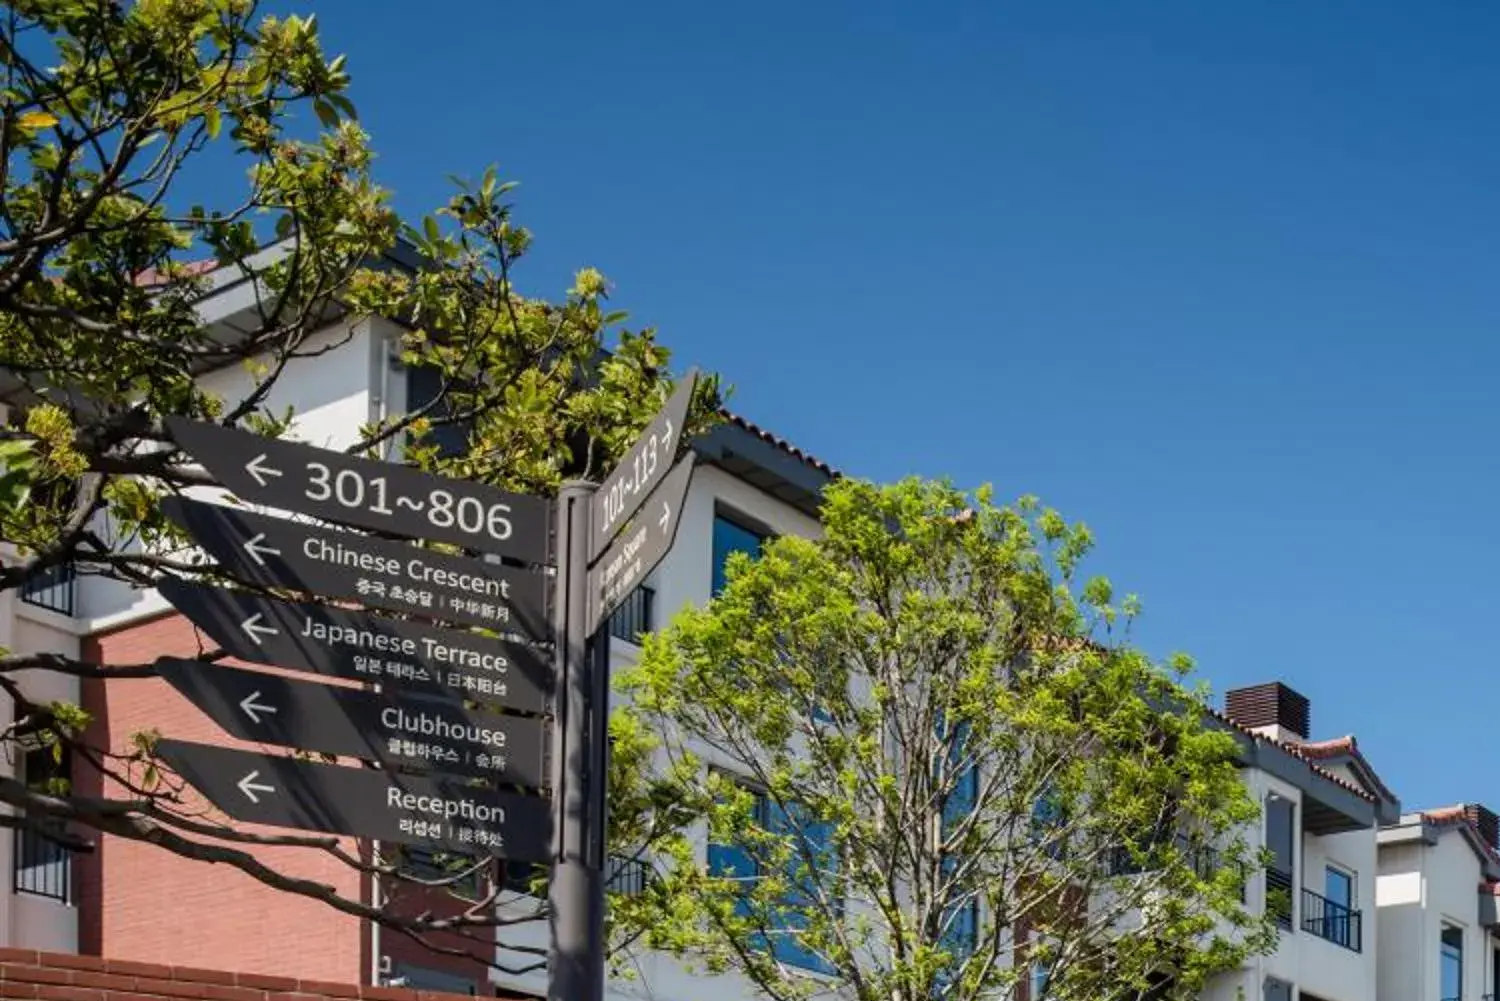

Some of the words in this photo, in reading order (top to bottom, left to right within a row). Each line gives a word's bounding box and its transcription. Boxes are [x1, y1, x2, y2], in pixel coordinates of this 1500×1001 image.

[304, 461, 514, 541] 301~806
[601, 434, 658, 533] 101~113
[303, 538, 400, 576] Chinese
[407, 559, 510, 599] Crescent
[356, 578, 386, 599] 중국
[301, 616, 415, 656] Japanese
[421, 637, 508, 674] Terrace
[353, 656, 382, 674] 일본
[386, 662, 431, 682] 테라스
[381, 708, 507, 748] Clubhouse
[387, 738, 460, 763] 클럽하우스
[387, 786, 506, 824] Reception
[399, 819, 441, 839] 리셉션
